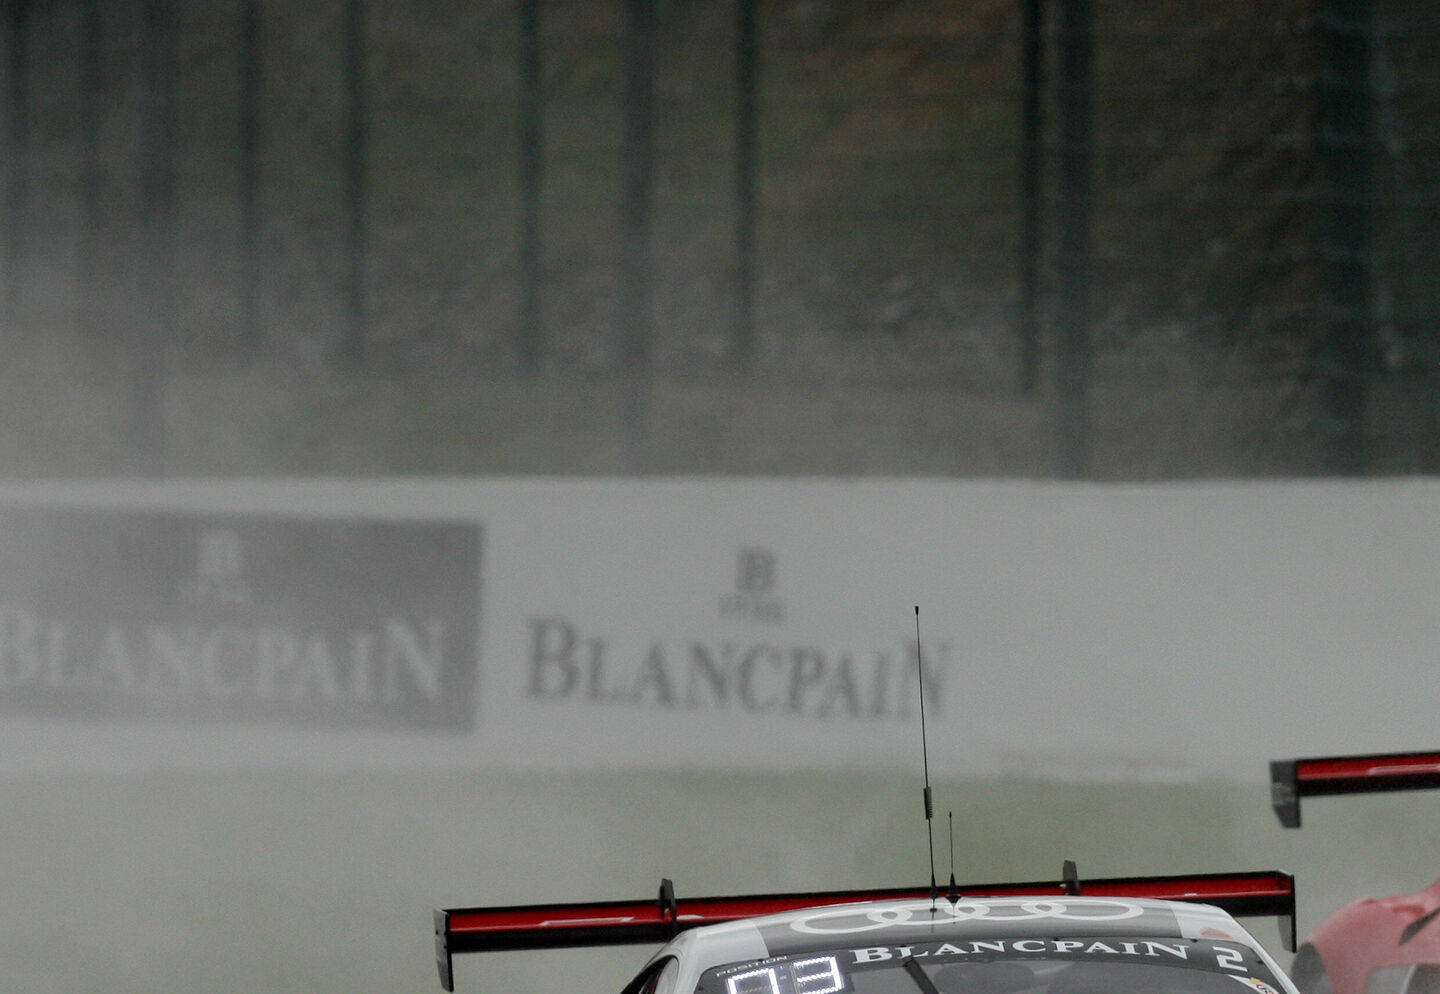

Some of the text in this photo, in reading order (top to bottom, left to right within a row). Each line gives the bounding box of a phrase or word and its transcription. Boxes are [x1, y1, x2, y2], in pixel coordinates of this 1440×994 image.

[526, 615, 951, 719] BLANCPAIN
[716, 955, 788, 977] POSITION
[851, 939, 1249, 972] BLANCPAIN 2
